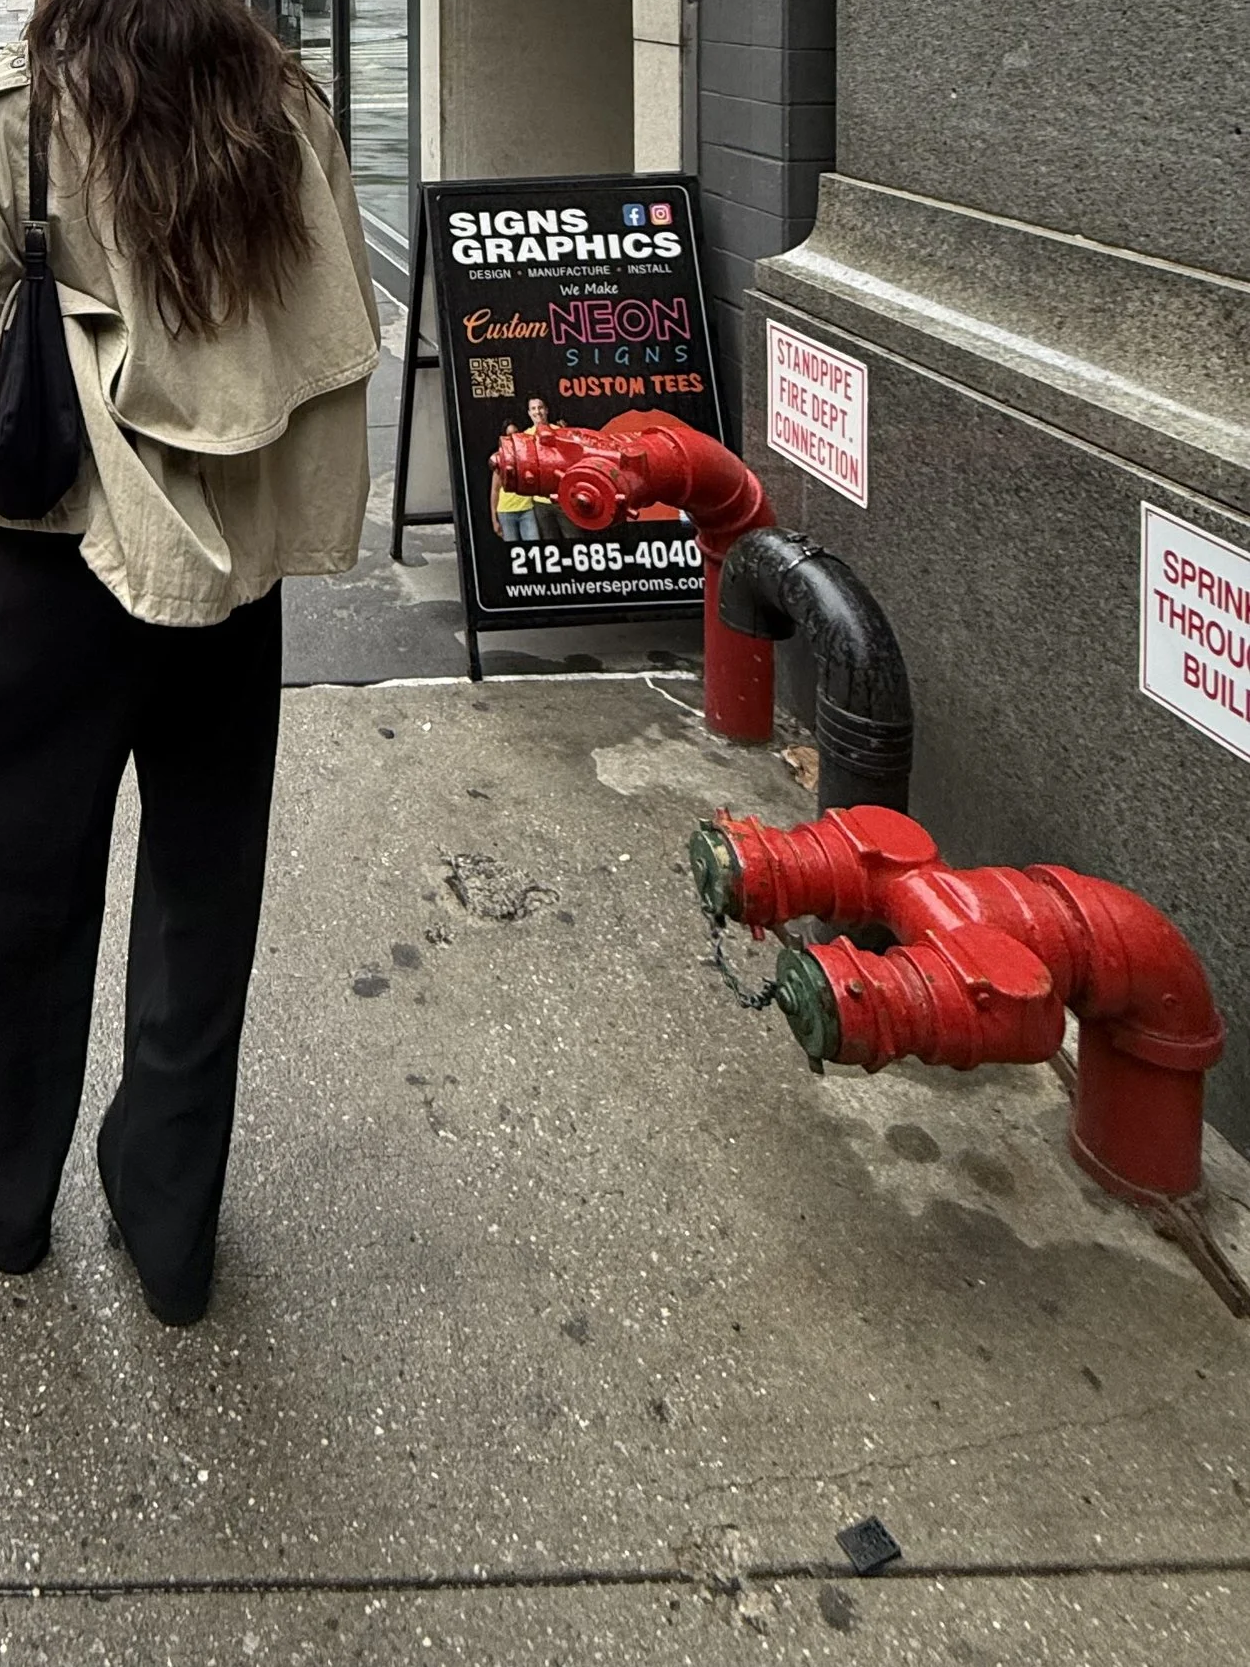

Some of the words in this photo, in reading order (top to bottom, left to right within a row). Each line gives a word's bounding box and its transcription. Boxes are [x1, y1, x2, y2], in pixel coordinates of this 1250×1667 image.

[449, 208, 589, 237] SIGNS
[452, 232, 682, 265] GRAPHICS
[469, 269, 511, 280] DESIGN
[528, 265, 611, 277] MANUFACTURE
[628, 264, 672, 274] INSTALL
[560, 284, 580, 296] We
[585, 282, 619, 295] Make
[463, 309, 548, 344] Custom
[549, 298, 691, 345] NEON
[566, 345, 688, 366] SIGNS
[777, 337, 853, 402] STANDPIPE
[559, 376, 645, 397] CUSTOM
[650, 373, 704, 394] TEES
[780, 376, 808, 417] FIRE
[812, 394, 854, 443] DEPT.
[775, 411, 859, 487] CONNECTION
[510, 539, 702, 575] 212-685-4040
[1154, 588, 1250, 671] THROU
